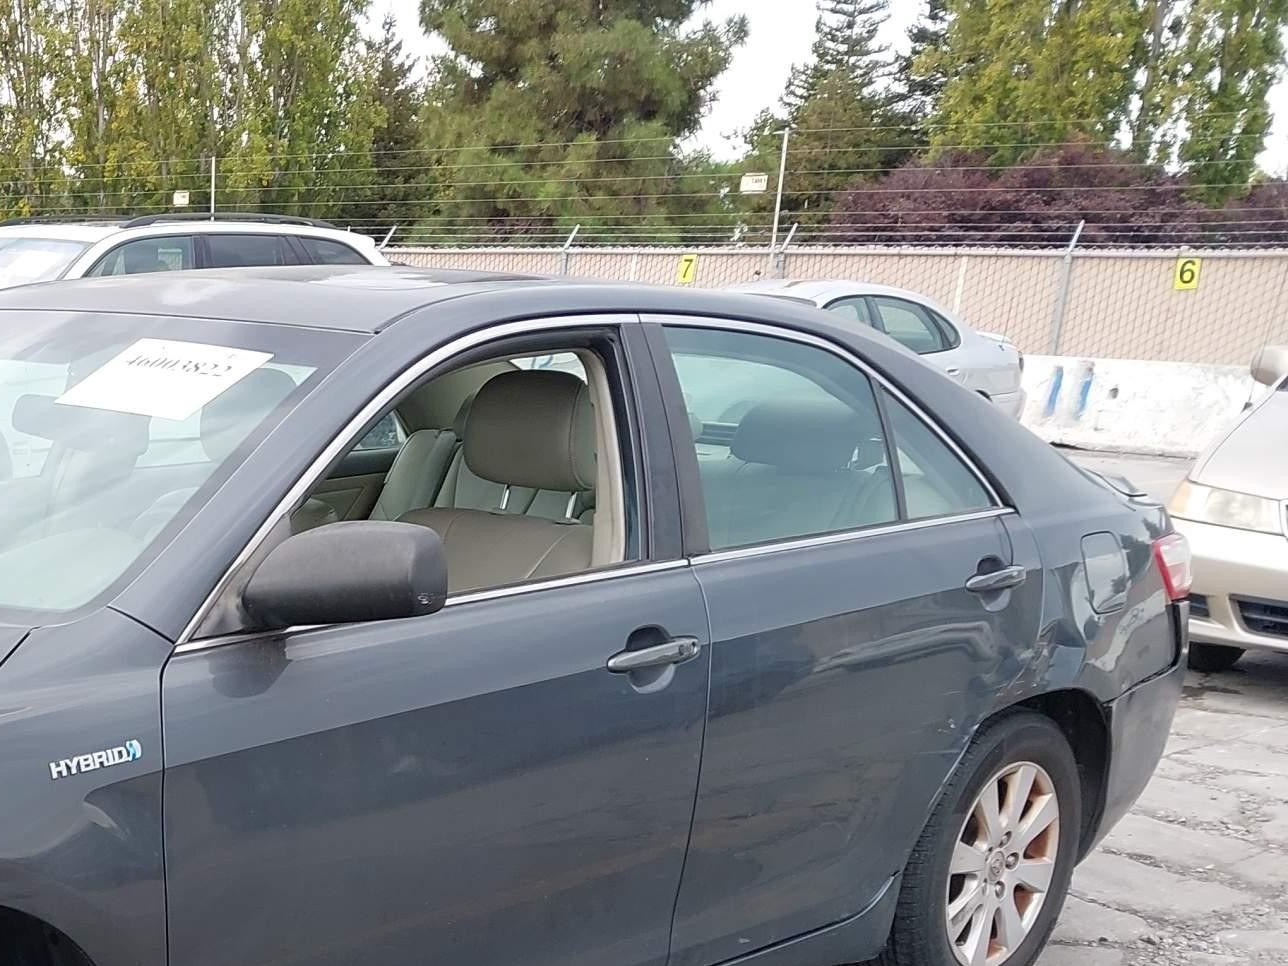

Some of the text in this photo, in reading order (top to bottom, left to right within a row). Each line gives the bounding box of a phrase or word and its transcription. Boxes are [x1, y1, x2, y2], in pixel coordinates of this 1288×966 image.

[683, 258, 693, 279] 7
[1179, 260, 1196, 284] 6
[126, 355, 232, 377] 46003822
[49, 745, 130, 779] HYBRID
